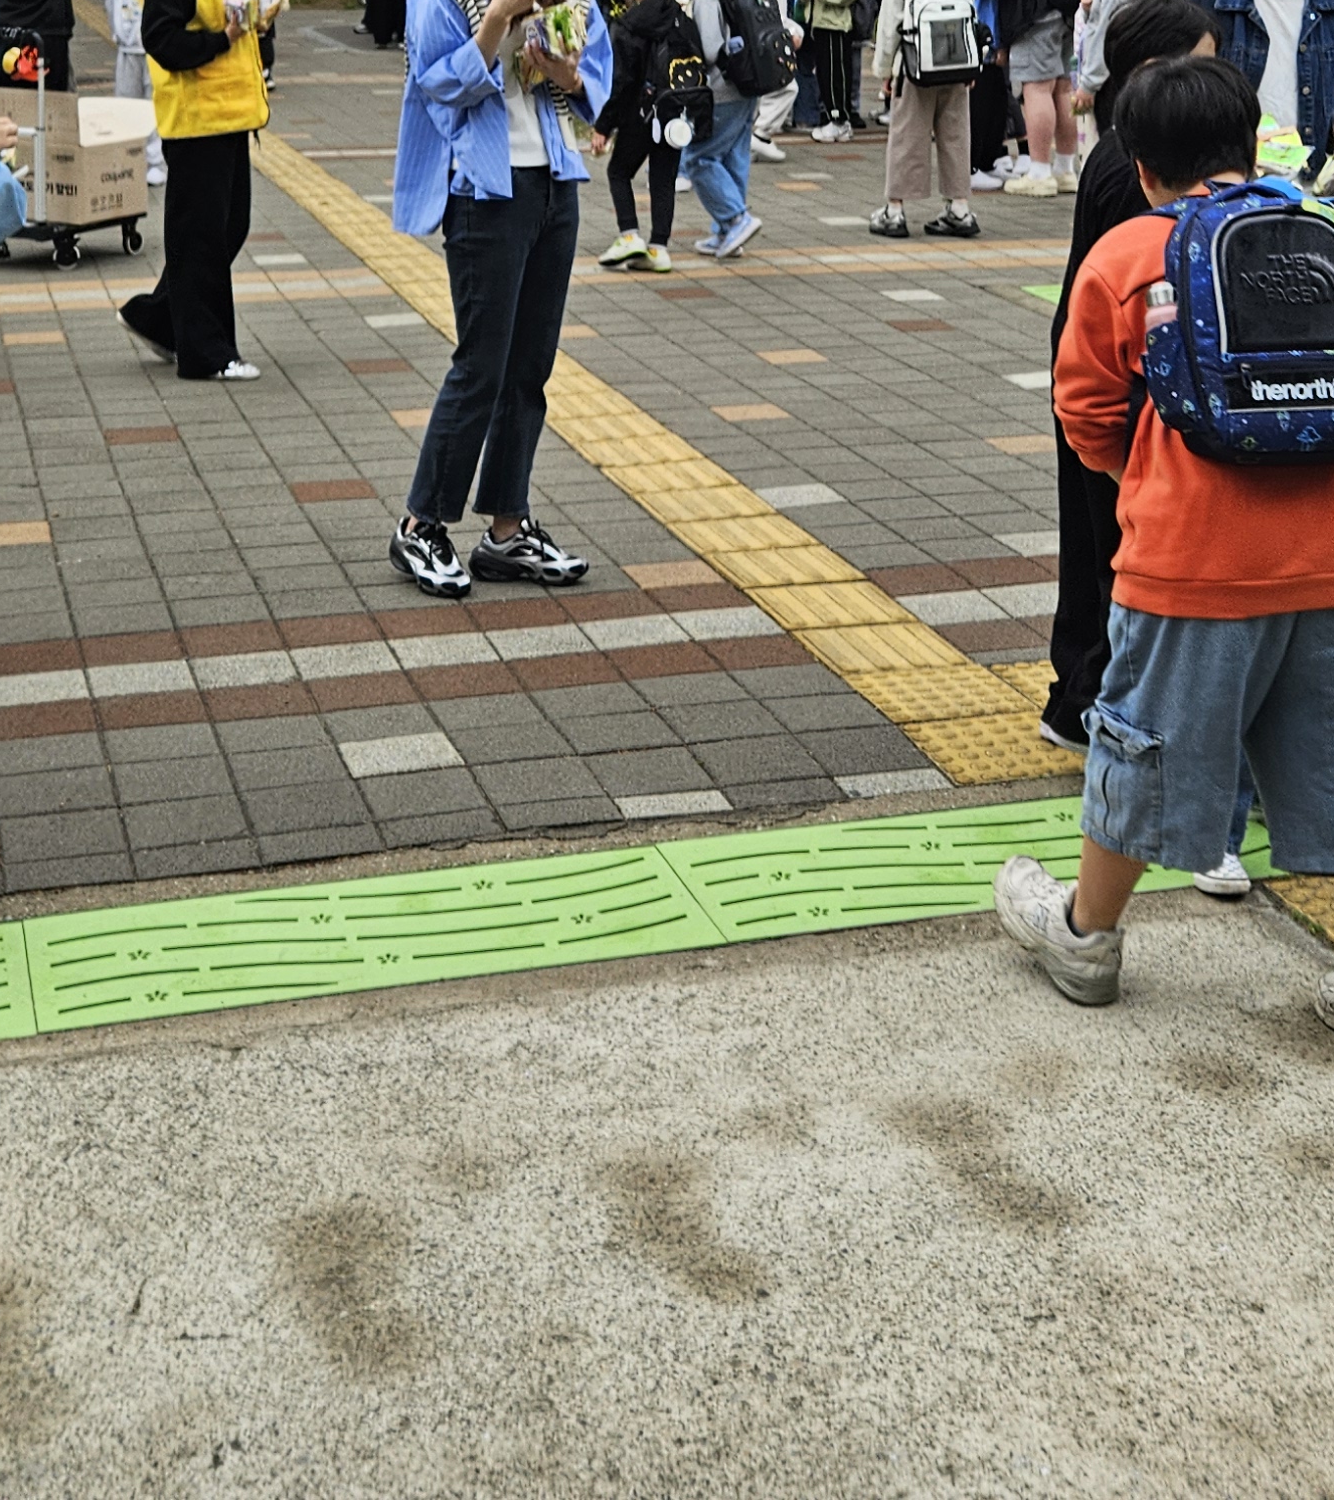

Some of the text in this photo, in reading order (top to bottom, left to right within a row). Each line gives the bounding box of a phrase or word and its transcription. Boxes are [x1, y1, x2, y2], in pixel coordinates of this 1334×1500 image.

[1267, 252, 1307, 269] THE
[1239, 269, 1312, 291] NORTH
[1265, 284, 1316, 304] FACE
